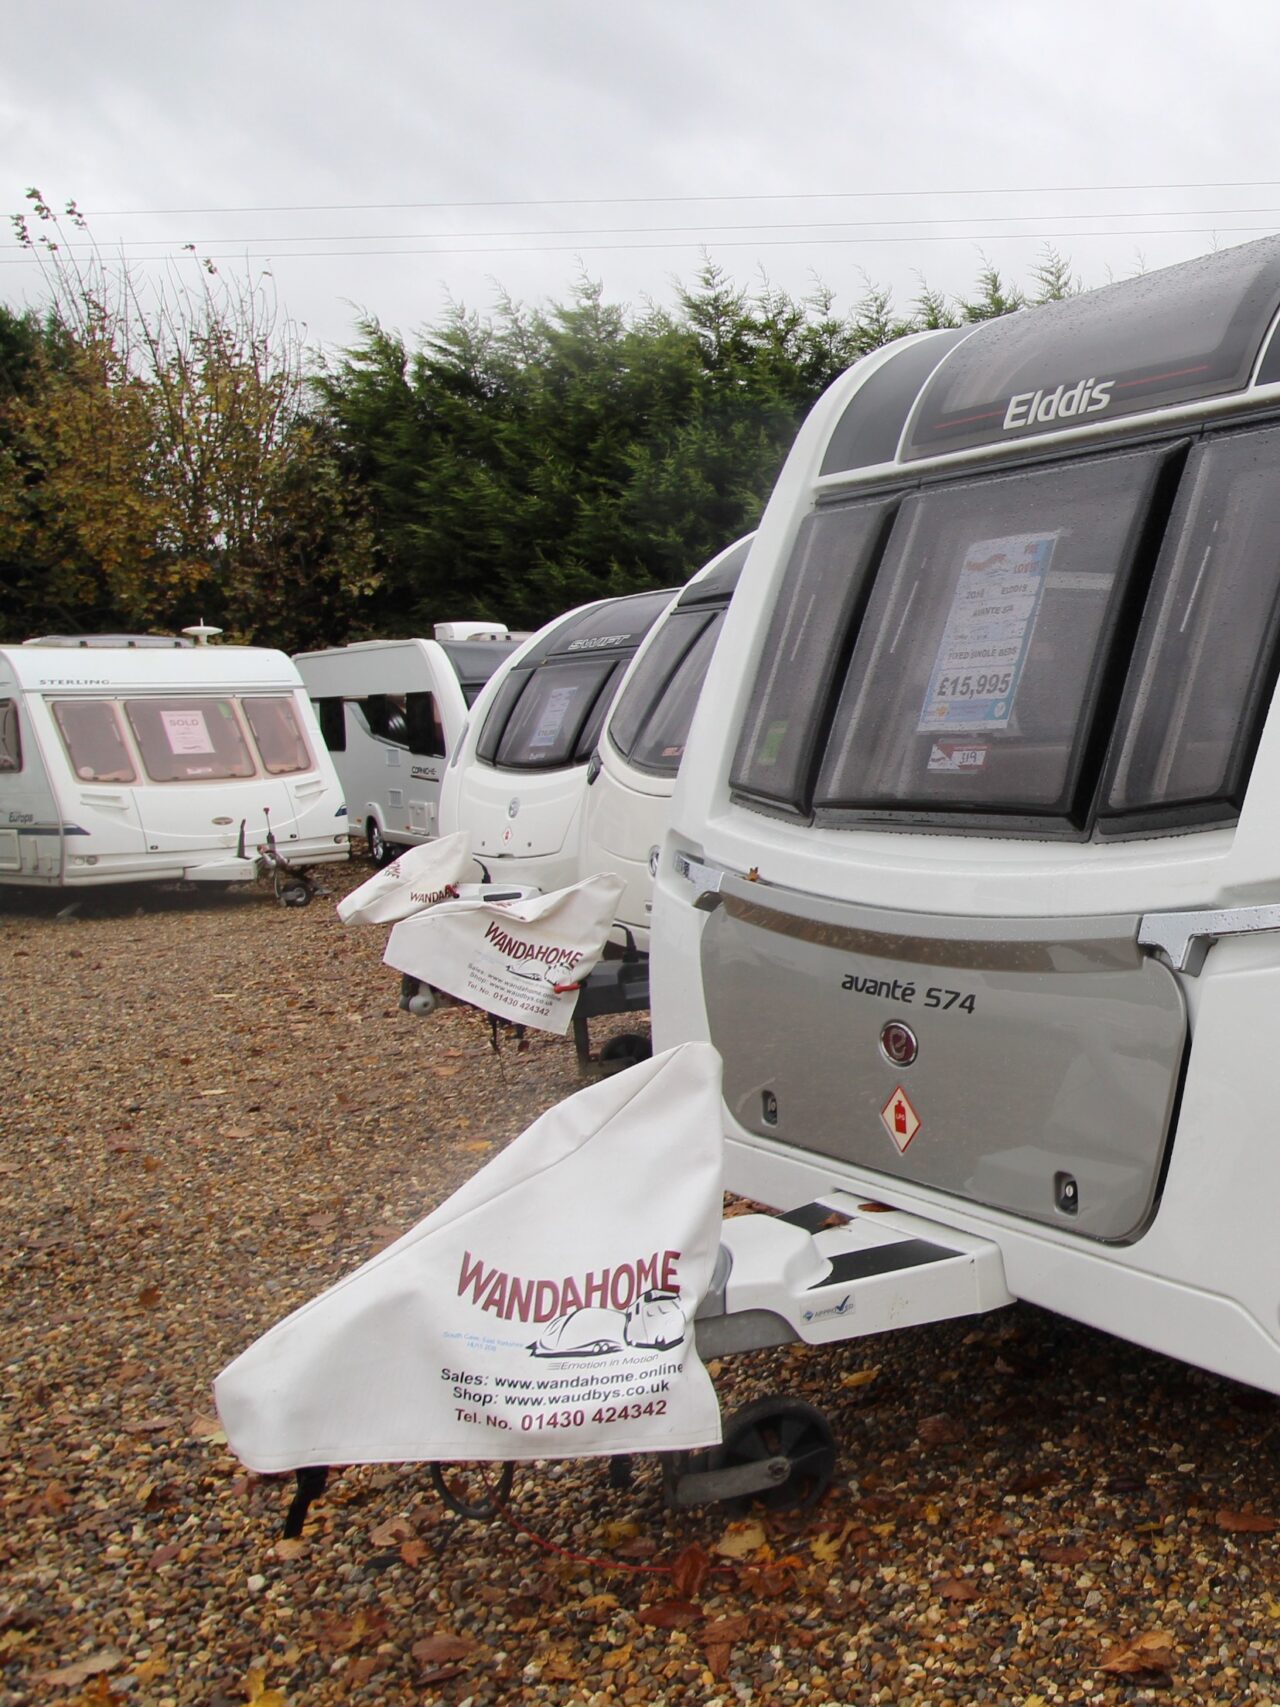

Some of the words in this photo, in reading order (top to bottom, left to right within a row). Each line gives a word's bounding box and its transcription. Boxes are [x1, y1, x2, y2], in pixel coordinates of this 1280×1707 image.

[1003, 377, 1116, 430] Elddis
[568, 634, 631, 650] SWIFT
[937, 673, 1012, 699] £15,995
[169, 719, 200, 727] SOLD
[484, 921, 584, 970] WANDAHOME
[492, 992, 519, 1007] 01430
[519, 1002, 551, 1017] 424342
[841, 974, 916, 1004] avanté
[924, 987, 976, 1015] 574
[457, 1250, 681, 1324] WANDAHOME
[560, 1360, 607, 1371] Emotion
[609, 1358, 620, 1367] in
[621, 1353, 660, 1365] Motion
[440, 1368, 489, 1387] Sales:
[494, 1362, 684, 1391] www.wandahome.online
[453, 1387, 498, 1407] Shop:
[504, 1380, 670, 1407] www.waudbys.co.uk
[454, 1408, 482, 1425] Tel.
[486, 1415, 513, 1431] No.
[521, 1410, 585, 1432] 01430
[592, 1400, 668, 1425] 424342
